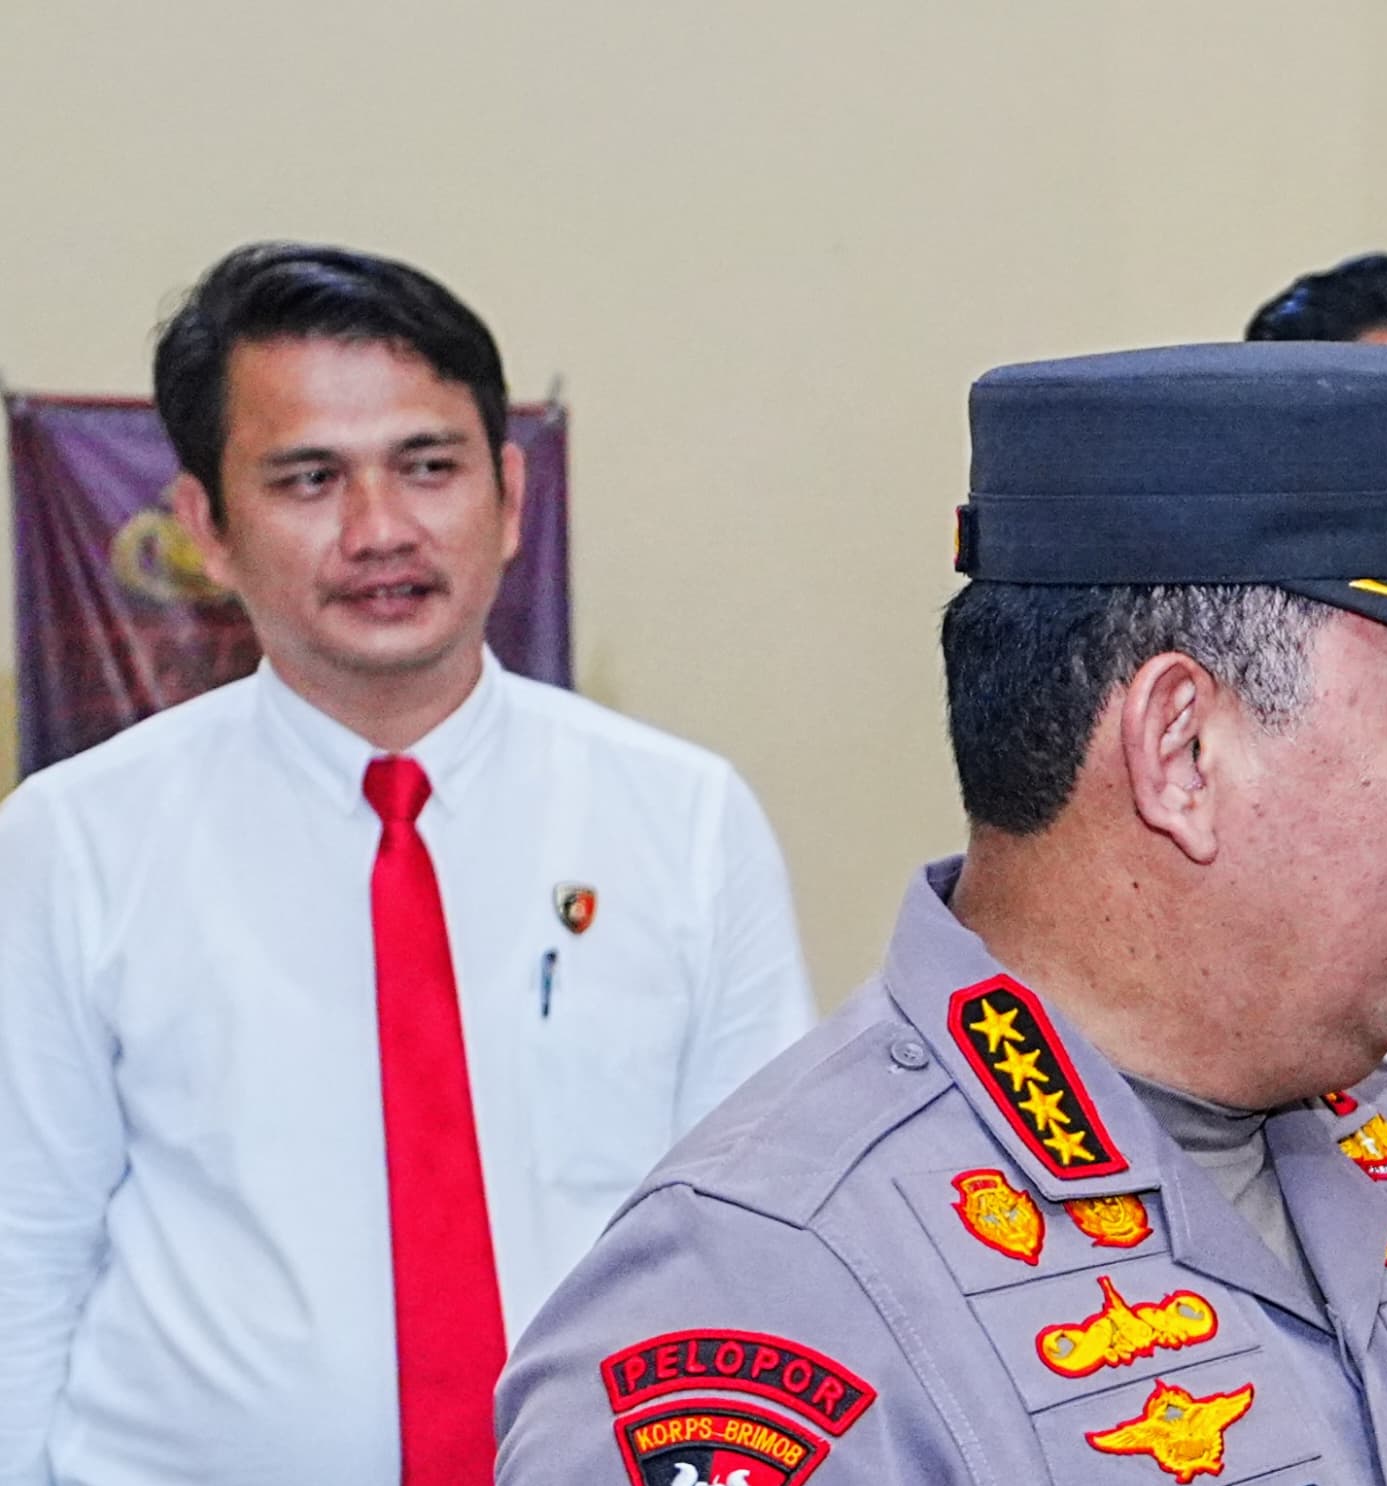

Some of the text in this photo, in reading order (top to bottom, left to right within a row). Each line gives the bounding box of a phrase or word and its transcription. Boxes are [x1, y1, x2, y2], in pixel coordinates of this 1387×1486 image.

[622, 1339, 847, 1415] PELOPOR
[635, 1416, 807, 1468] KORPS BRIMOB
